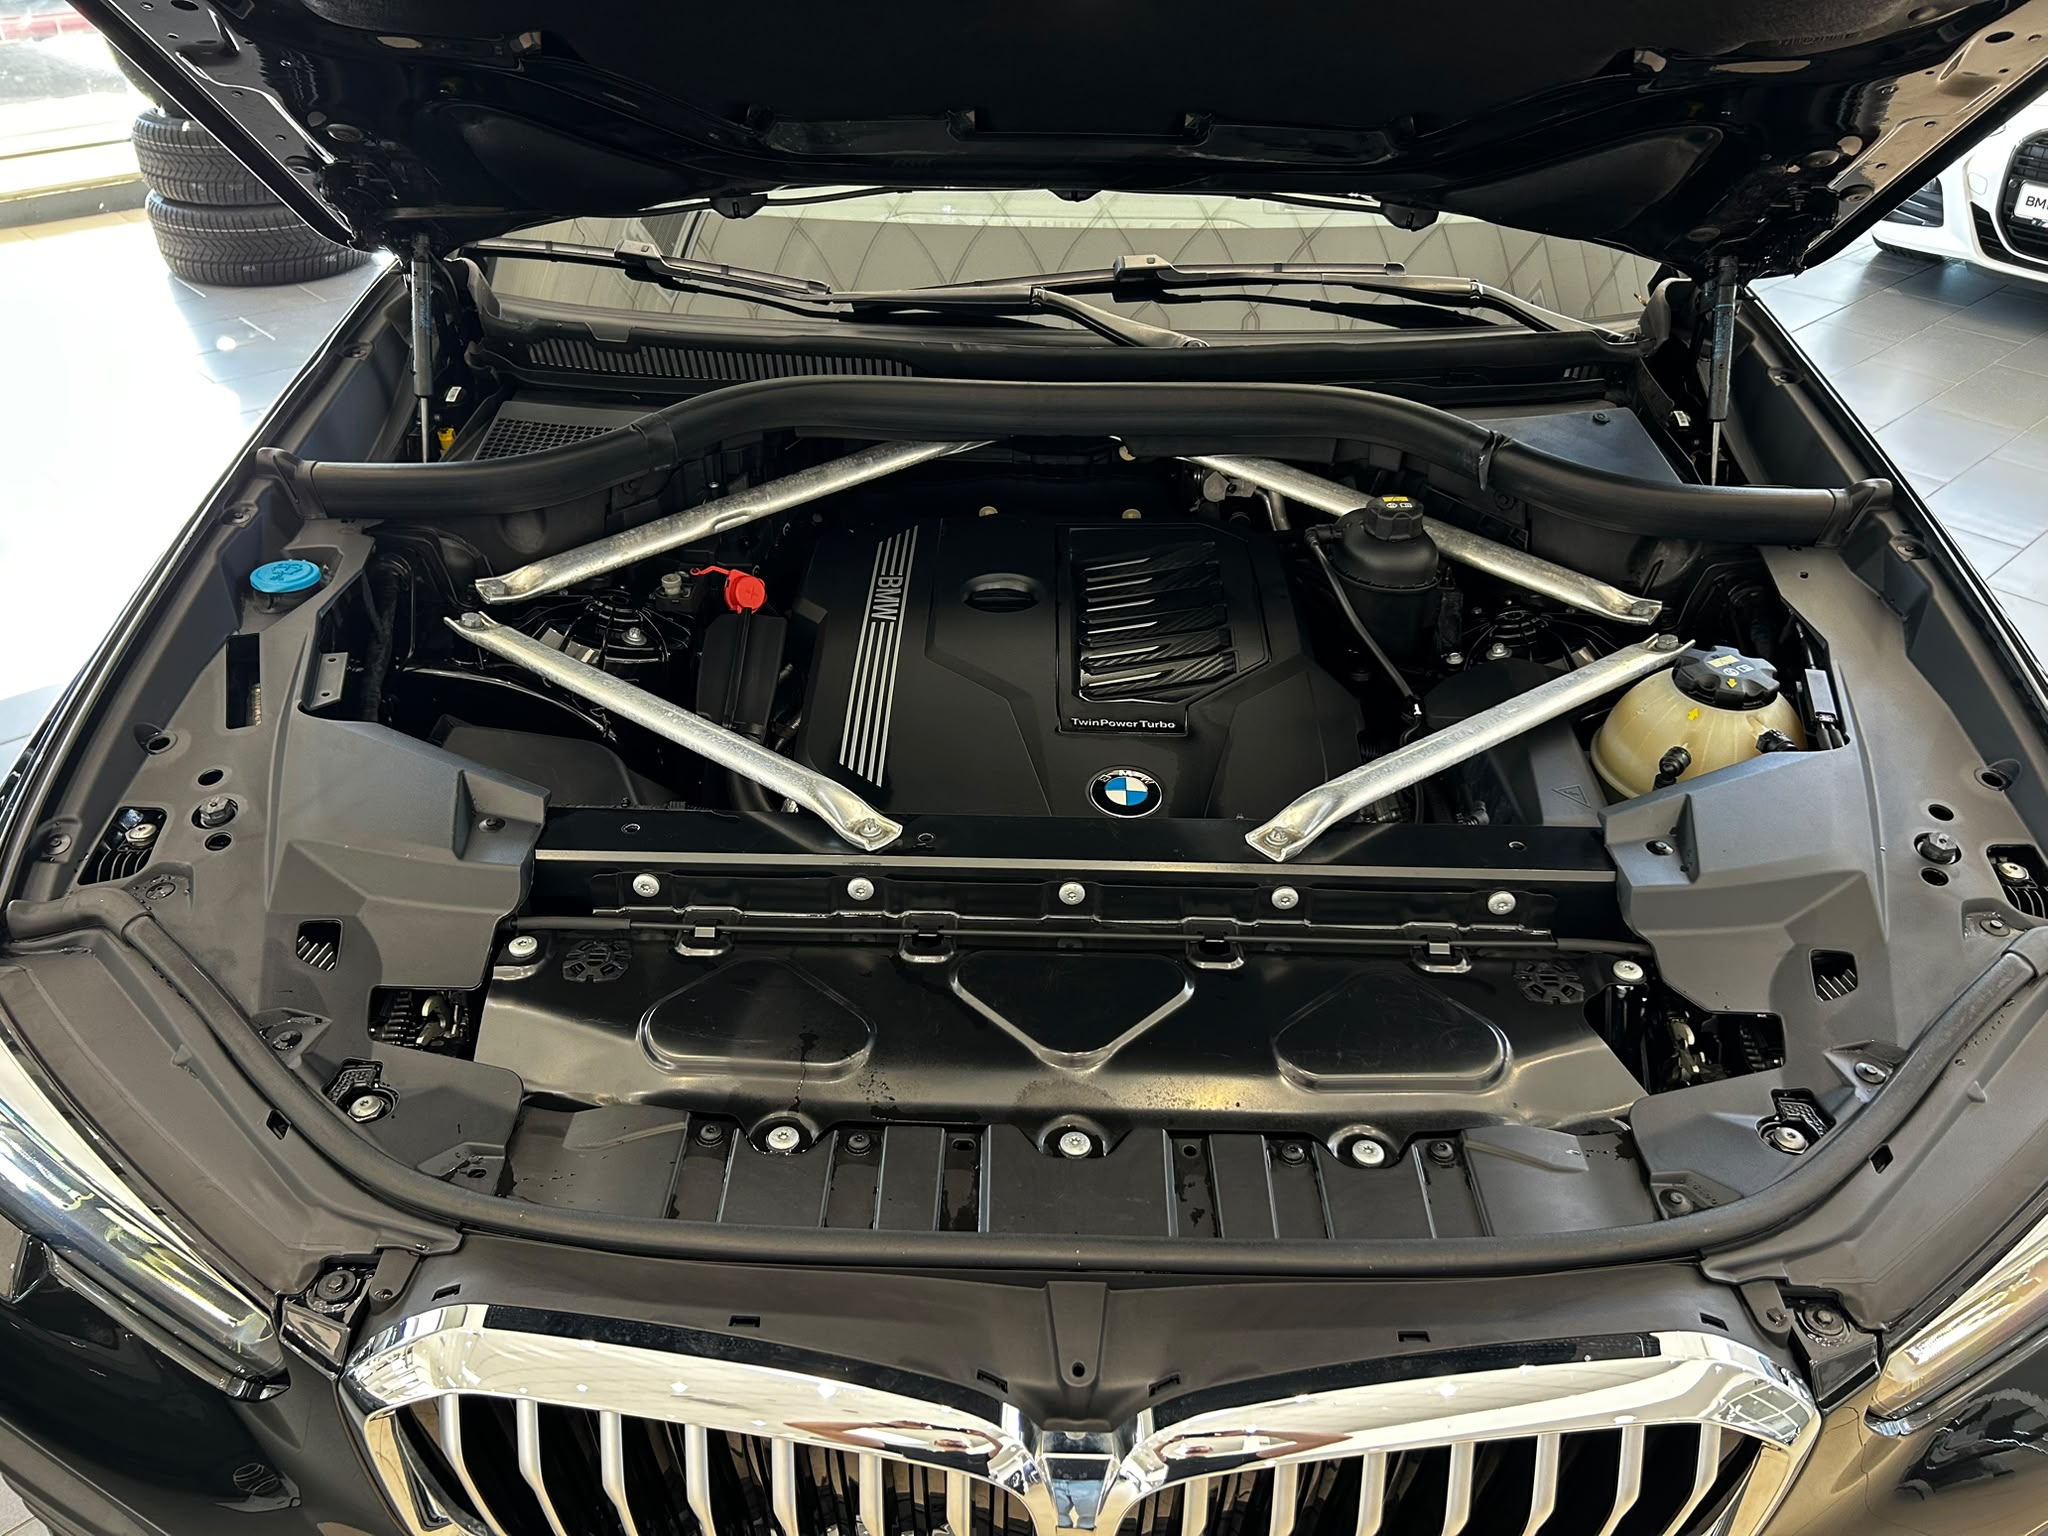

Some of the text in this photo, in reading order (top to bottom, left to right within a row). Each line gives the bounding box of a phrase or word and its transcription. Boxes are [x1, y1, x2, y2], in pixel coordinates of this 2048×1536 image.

[2025, 195, 2048, 210] BM
[871, 576, 904, 621] BMW
[1139, 720, 1176, 729] Turbo
[1098, 769, 1155, 785] BMW
